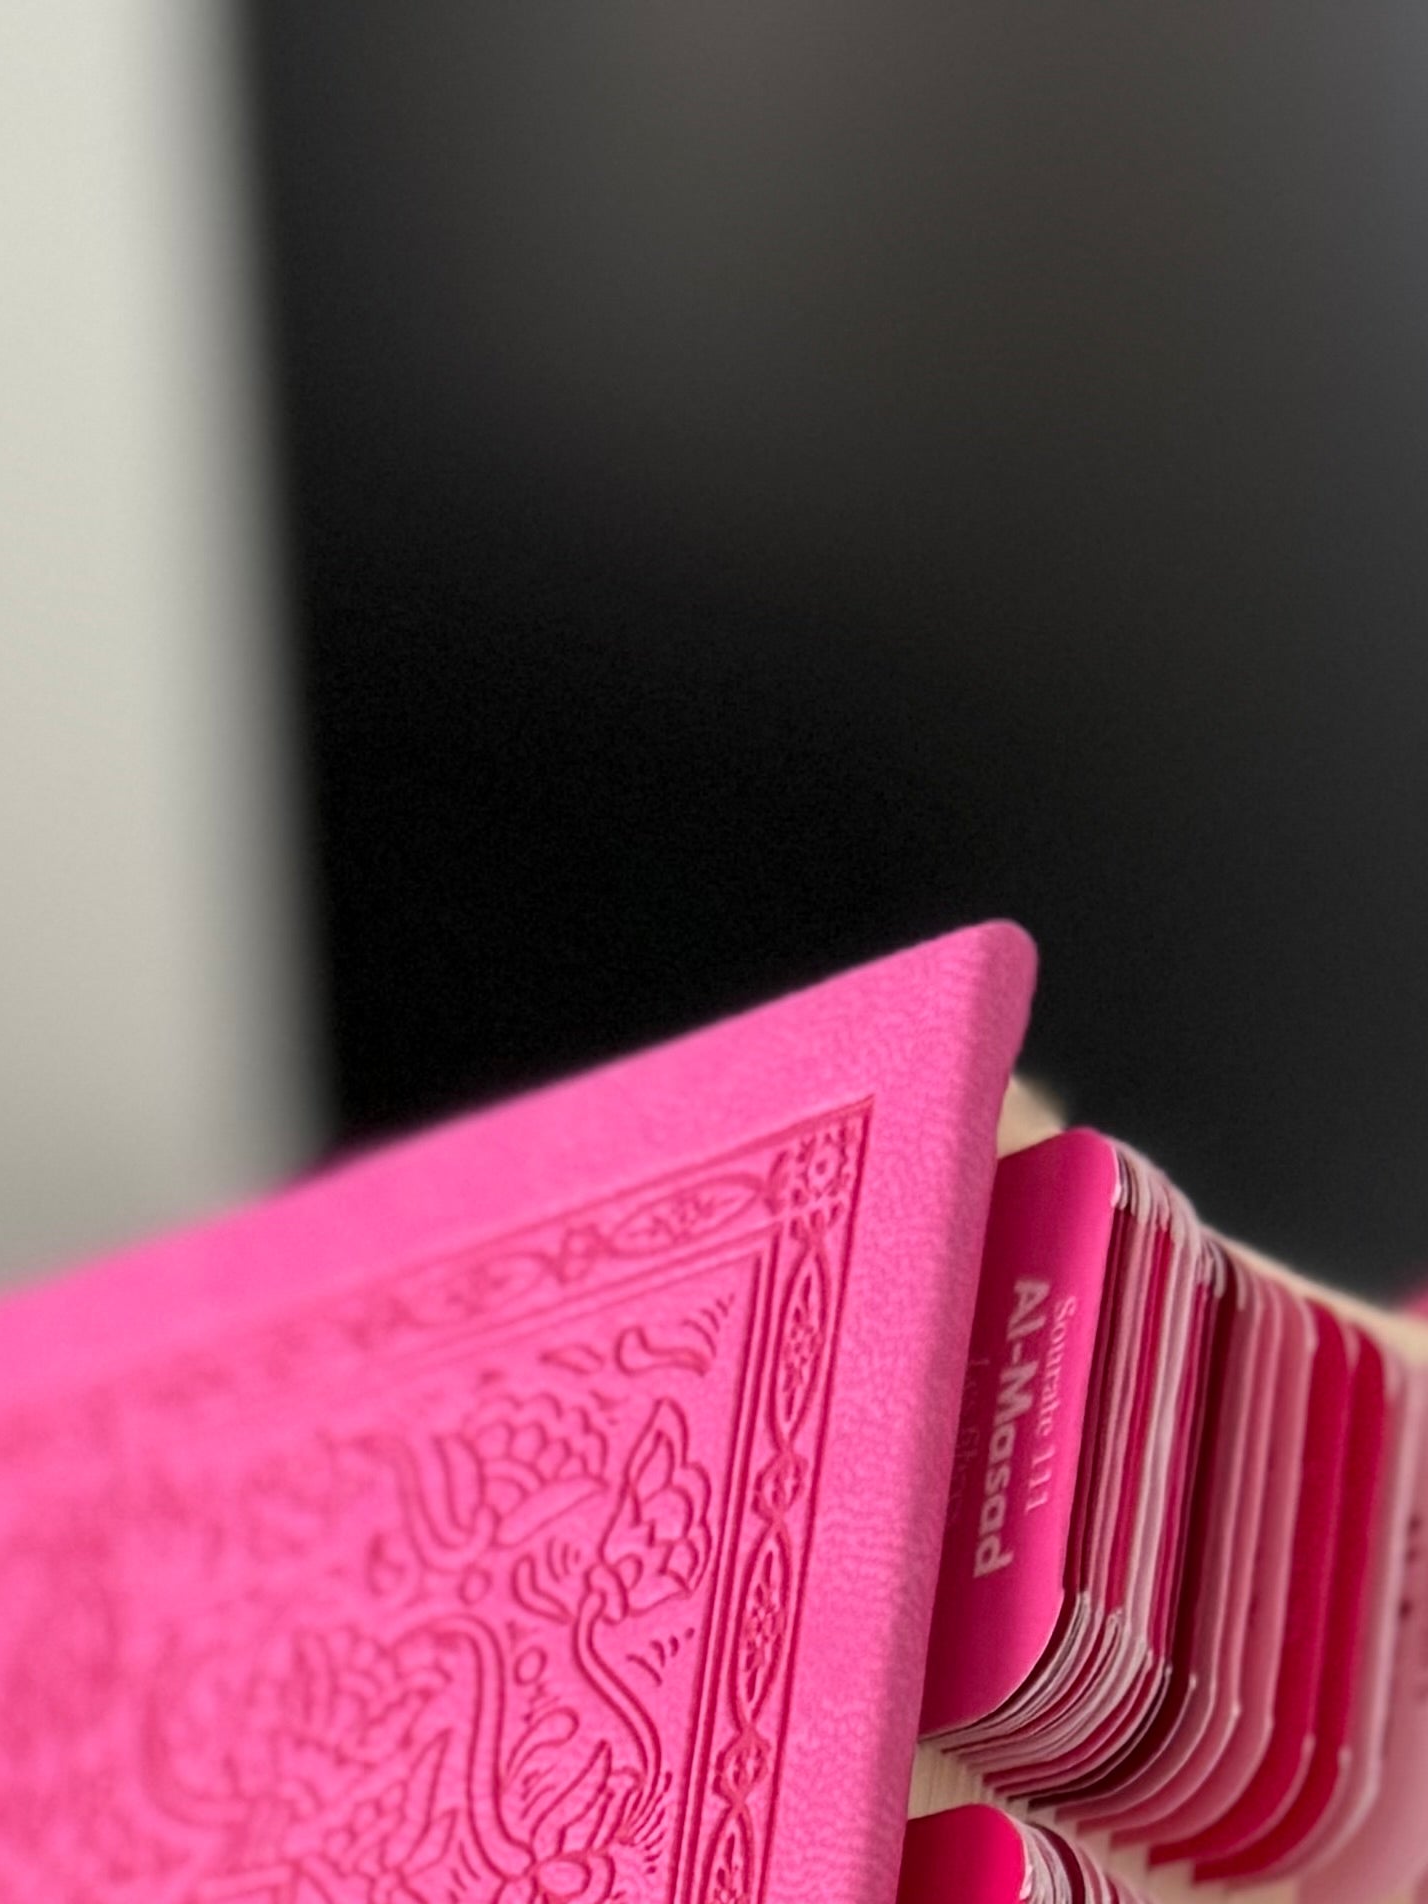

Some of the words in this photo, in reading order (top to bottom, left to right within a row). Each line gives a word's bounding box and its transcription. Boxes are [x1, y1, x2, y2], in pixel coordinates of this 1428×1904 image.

[973, 1277, 1051, 1578] Al-Masad
[1036, 1294, 1078, 1438] Sourate
[1025, 1446, 1055, 1514] 111
